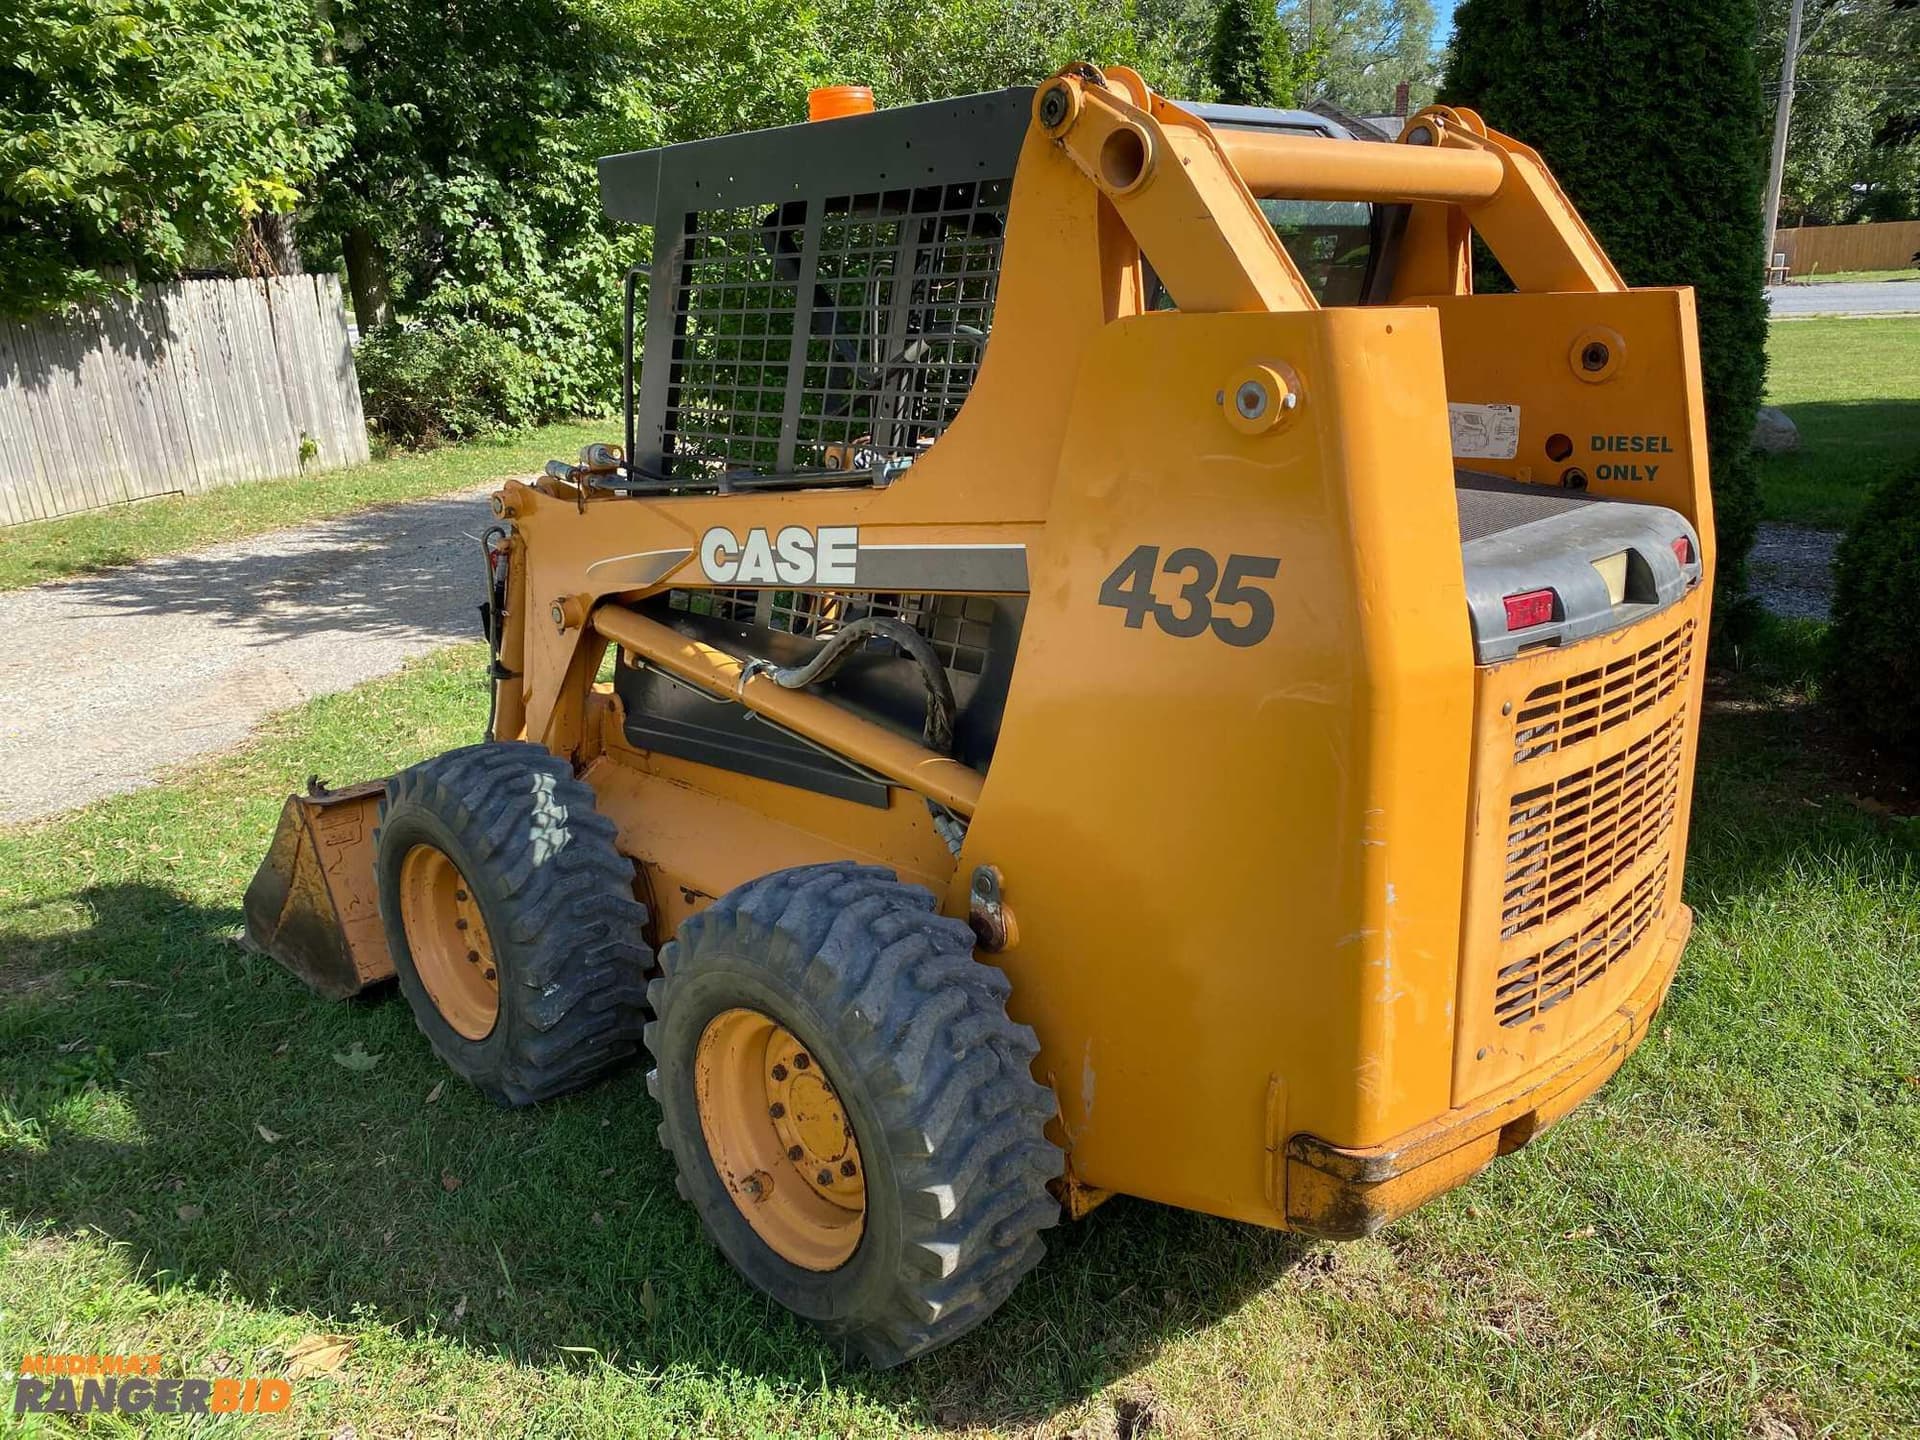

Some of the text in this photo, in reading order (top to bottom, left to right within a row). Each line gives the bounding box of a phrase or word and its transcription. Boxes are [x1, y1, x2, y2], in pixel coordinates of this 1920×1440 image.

[1591, 435, 1673, 453] DIESEL
[1596, 464, 1659, 481] ONLY
[700, 526, 859, 585] CASE
[1098, 545, 1281, 647] 435
